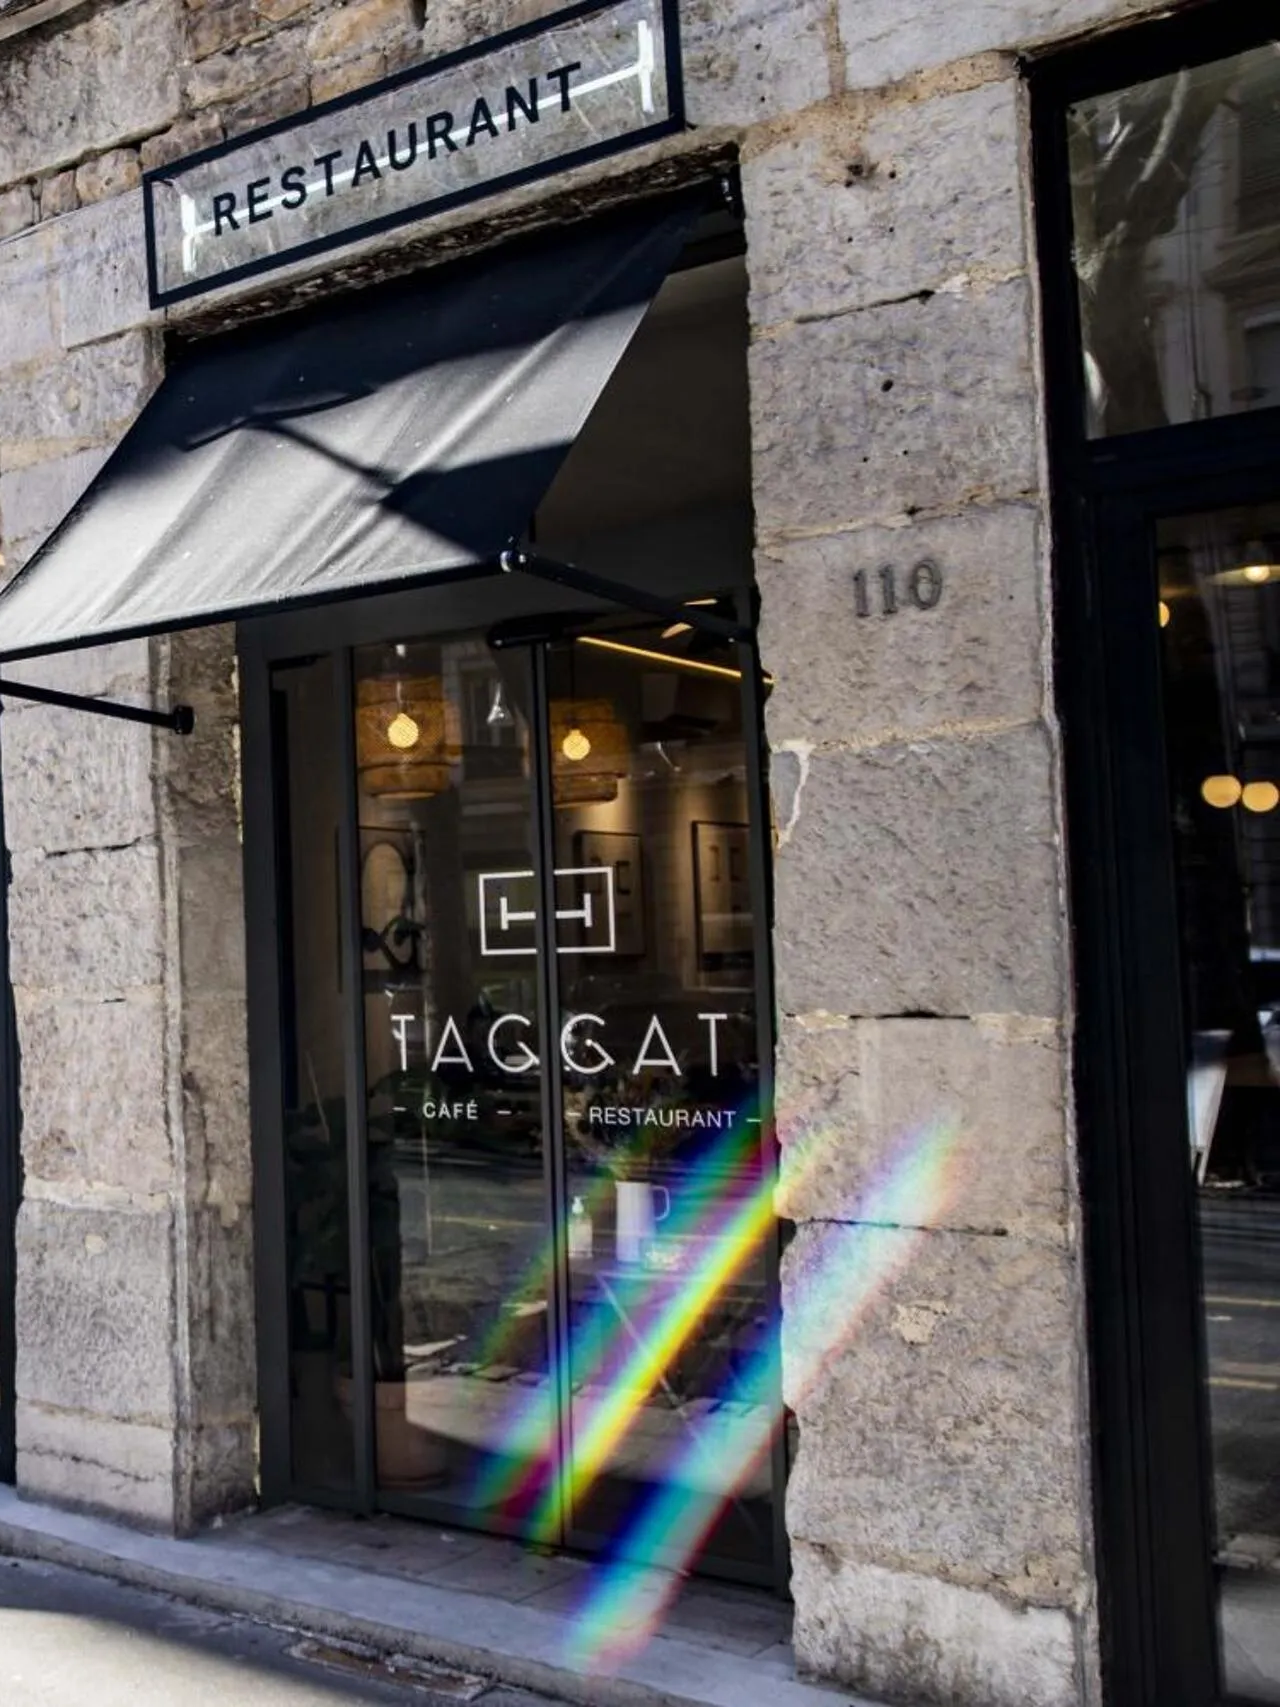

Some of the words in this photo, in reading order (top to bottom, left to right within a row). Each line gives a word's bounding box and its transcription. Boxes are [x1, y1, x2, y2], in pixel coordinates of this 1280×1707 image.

[212, 61, 582, 236] RESTAURANT
[853, 557, 943, 618] 110
[391, 1013, 728, 1077] TAGGAT
[422, 1100, 478, 1120] CAFÉ
[588, 1107, 736, 1129] RESTAURANT
